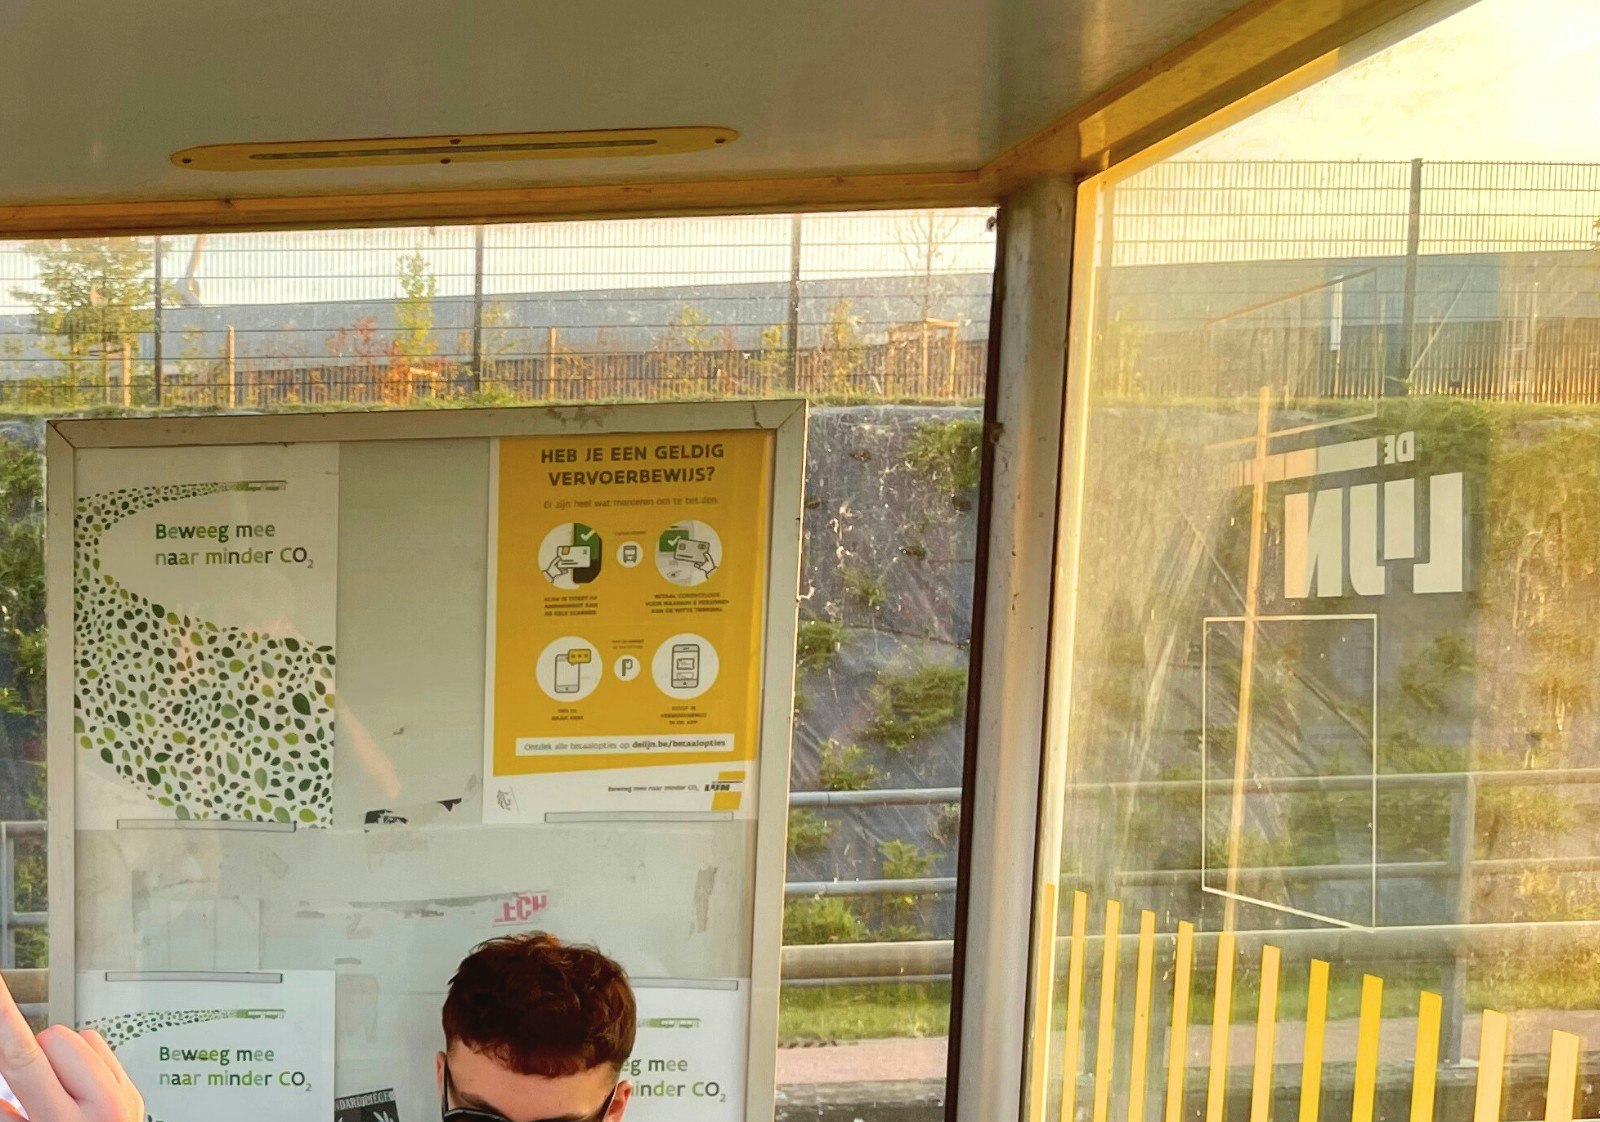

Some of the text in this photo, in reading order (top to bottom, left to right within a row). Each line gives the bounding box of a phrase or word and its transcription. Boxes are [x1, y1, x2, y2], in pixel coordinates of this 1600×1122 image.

[541, 443, 725, 463] HEB JE EEN GELDIG
[548, 466, 716, 486] VERVOERBEWIJS?
[155, 523, 276, 543] Beweeg mee
[155, 551, 199, 566] naar
[206, 547, 273, 565] minder
[159, 1046, 275, 1066] Beweeg mee
[648, 1059, 688, 1072] mee
[159, 1073, 201, 1087] naar
[207, 1069, 273, 1087] minder
